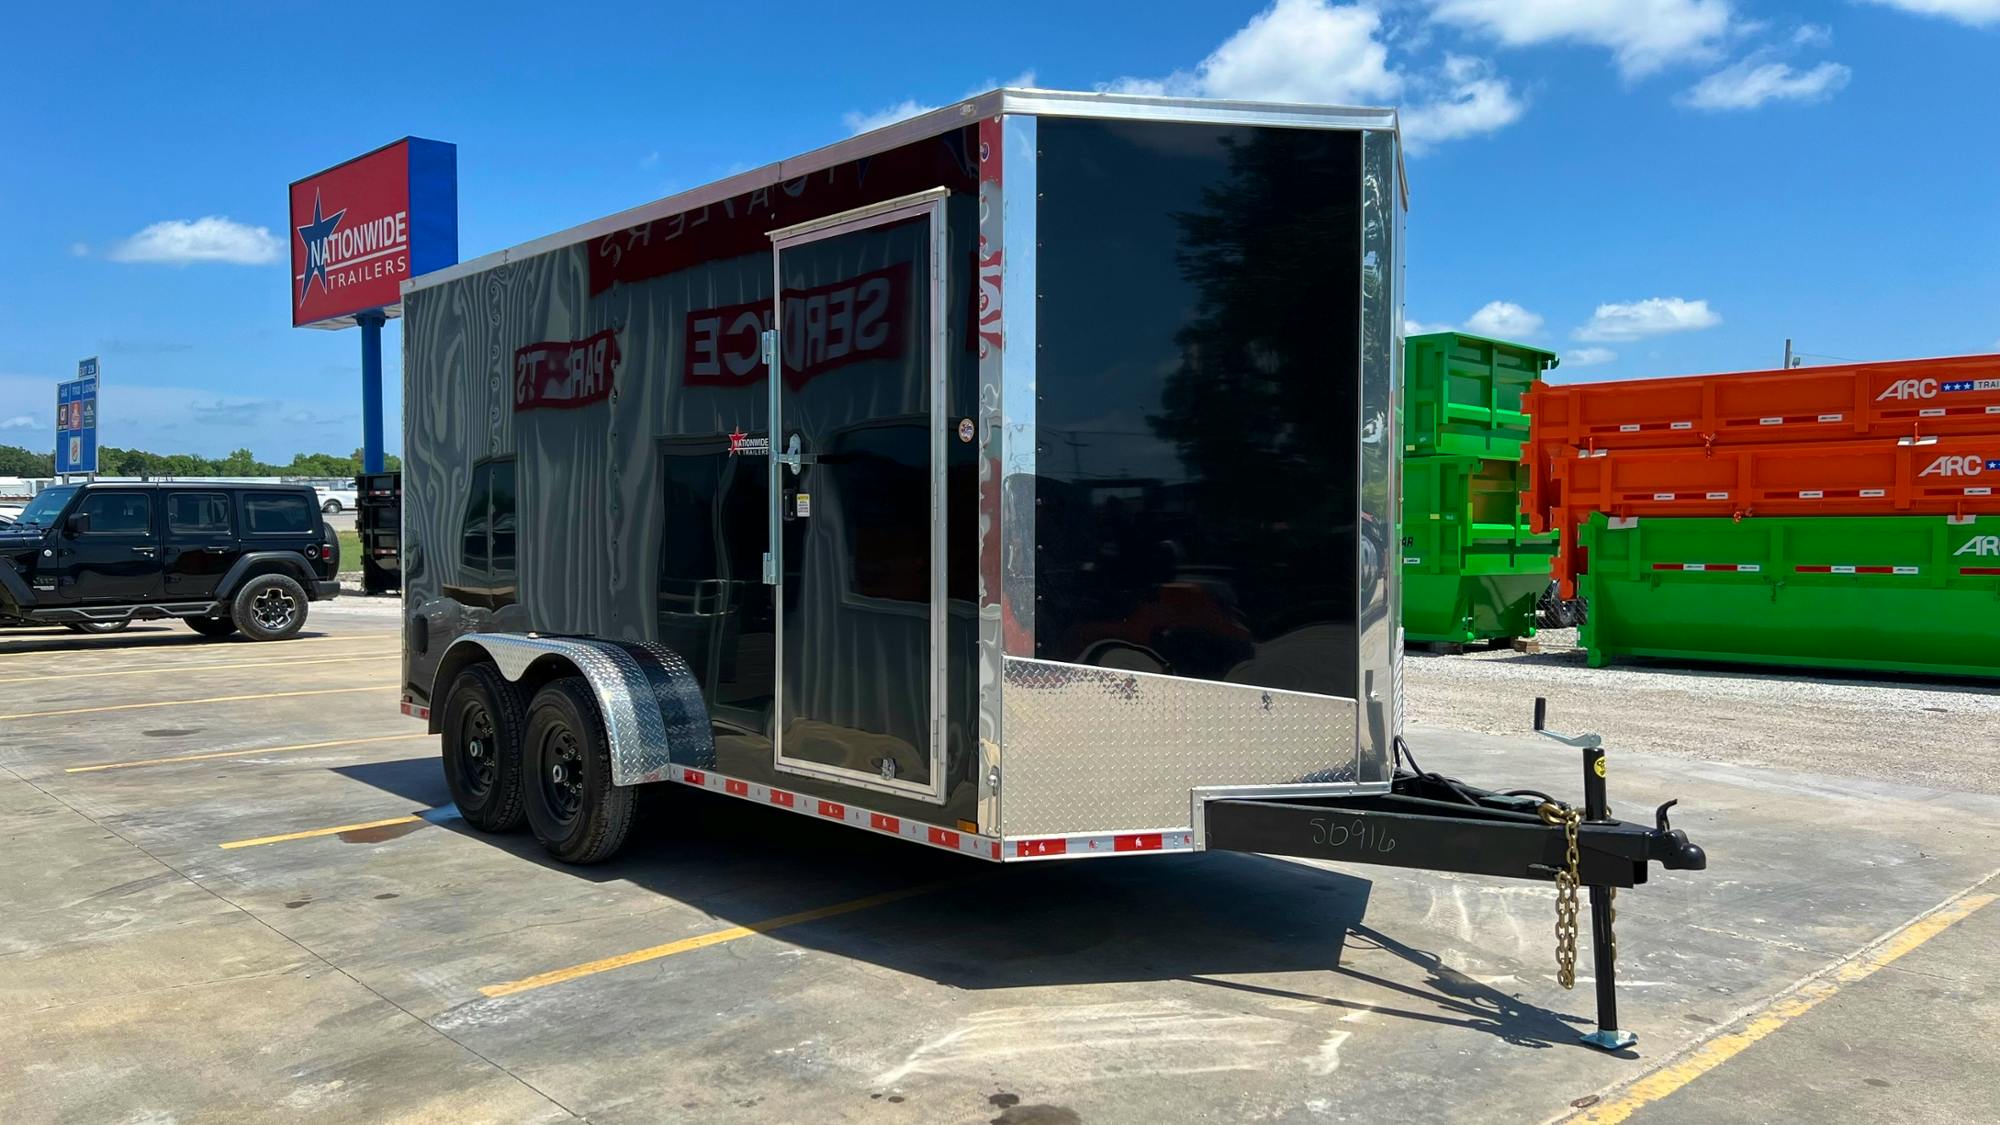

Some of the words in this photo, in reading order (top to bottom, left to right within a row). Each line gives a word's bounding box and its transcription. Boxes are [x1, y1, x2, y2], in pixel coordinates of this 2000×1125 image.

[311, 211, 407, 268] NATIONWIDE
[328, 256, 406, 290] TRAILERS
[1876, 378, 1938, 401] ARC
[734, 438, 769, 447] NATIONWIDE
[1918, 455, 1982, 477] ARC
[1953, 535, 2000, 557] AR
